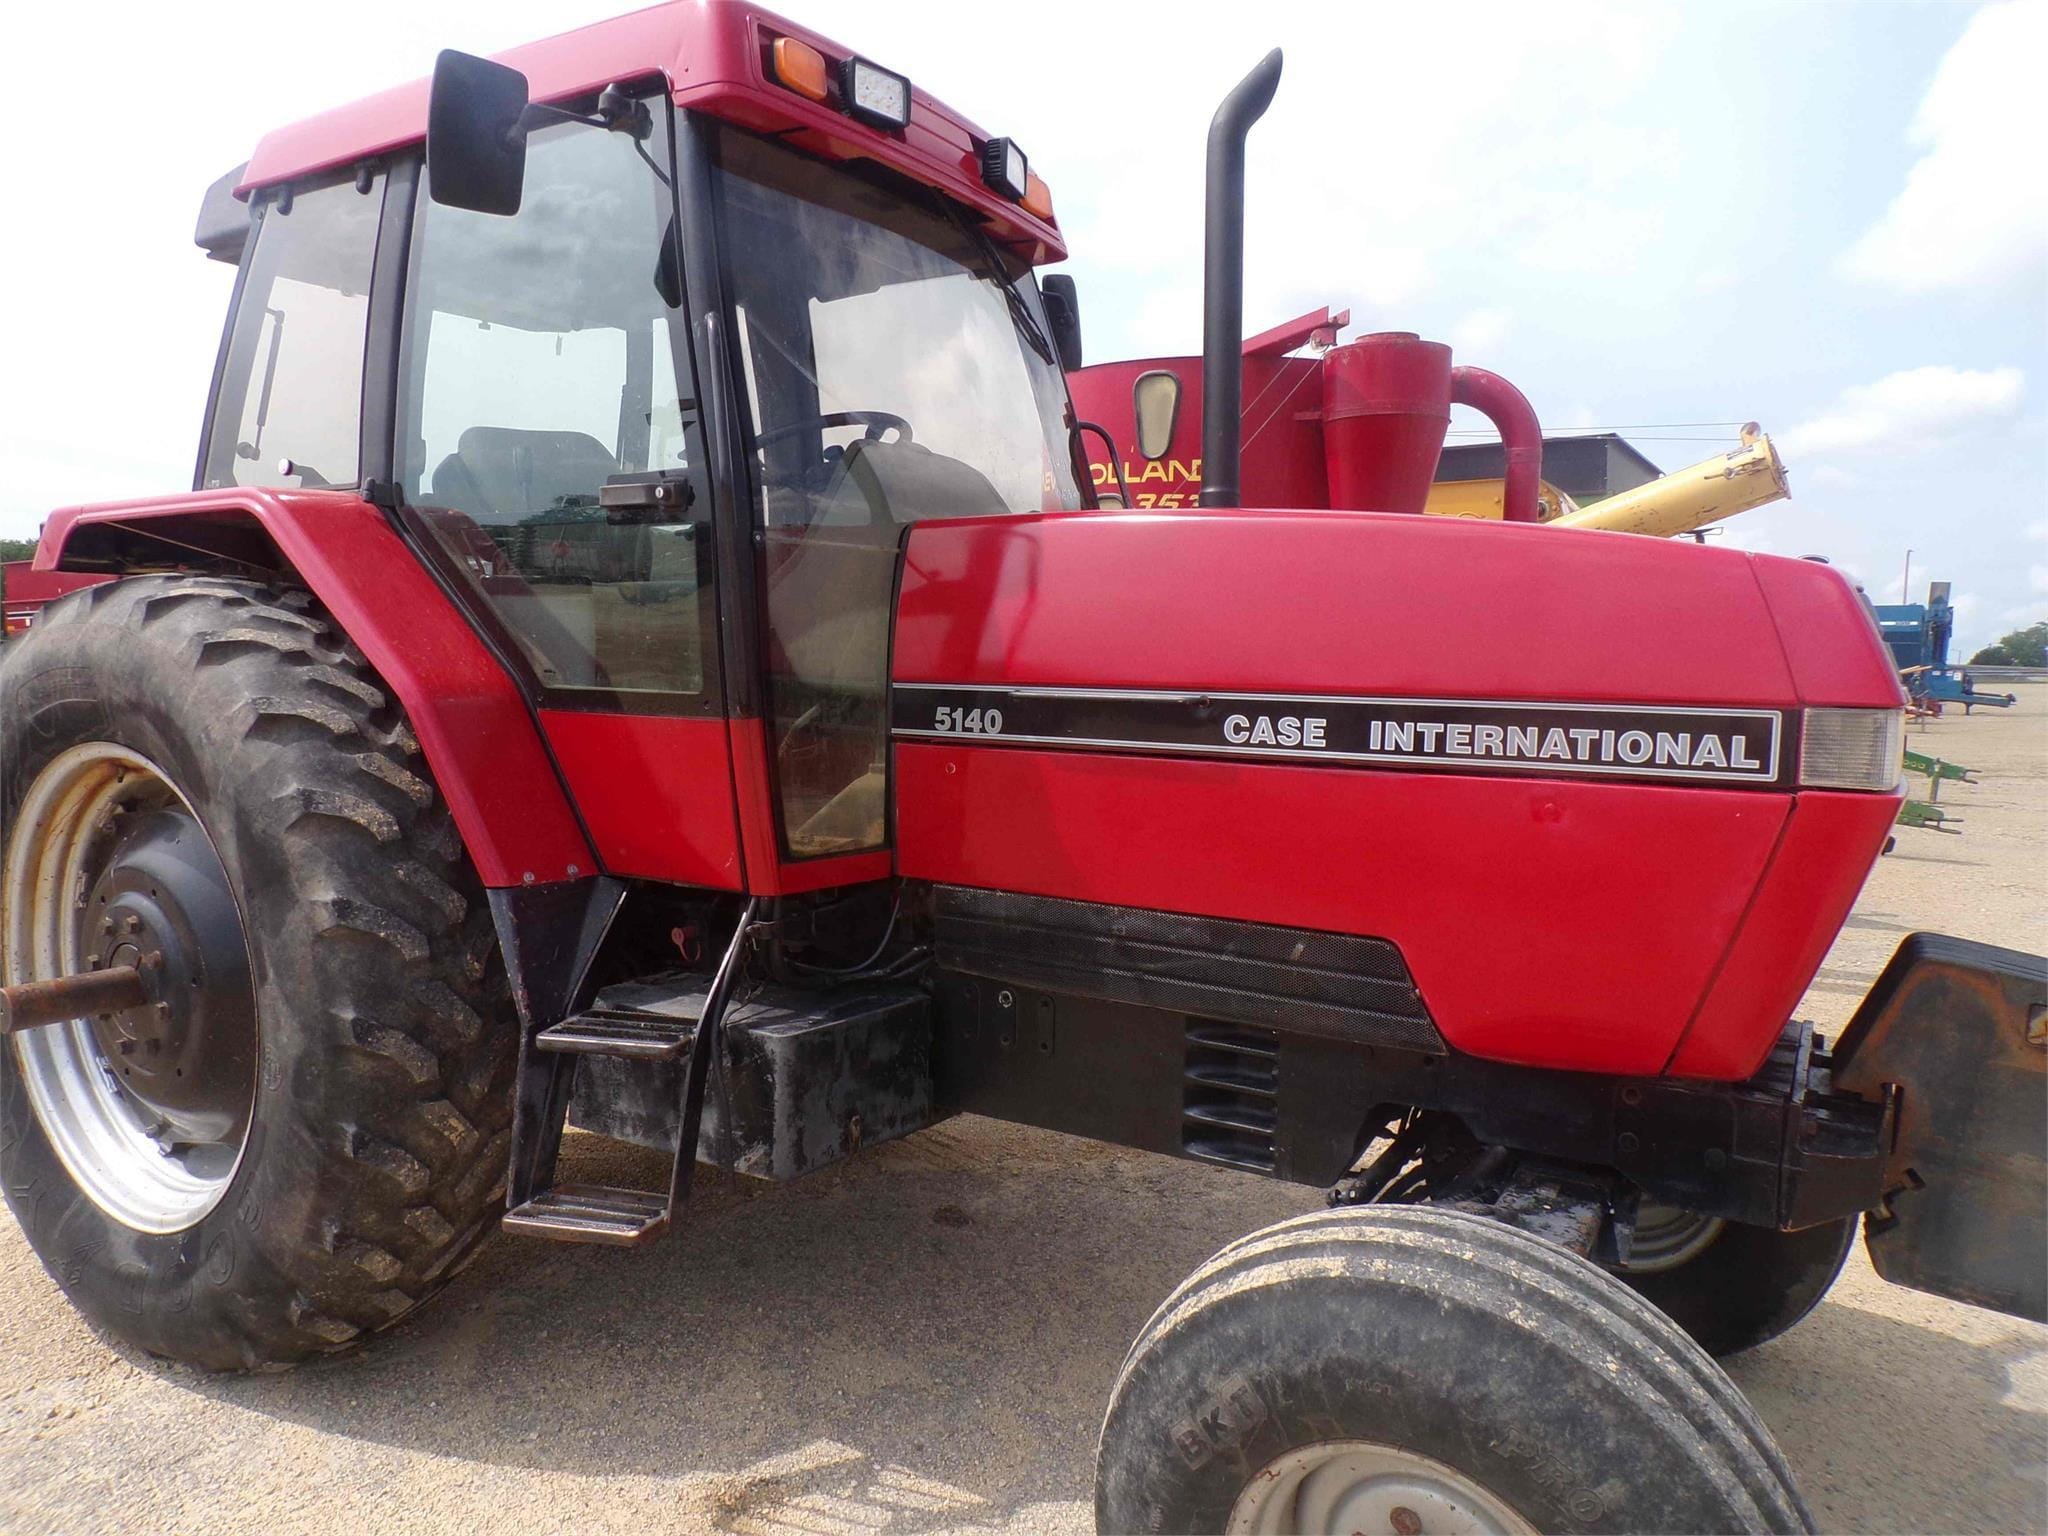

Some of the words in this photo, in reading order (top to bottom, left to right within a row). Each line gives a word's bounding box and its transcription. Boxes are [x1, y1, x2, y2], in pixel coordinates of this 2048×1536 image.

[934, 706, 1003, 734] 5140
[1223, 714, 1327, 747] CASE
[1369, 720, 1760, 769] INTERNATIONAL
